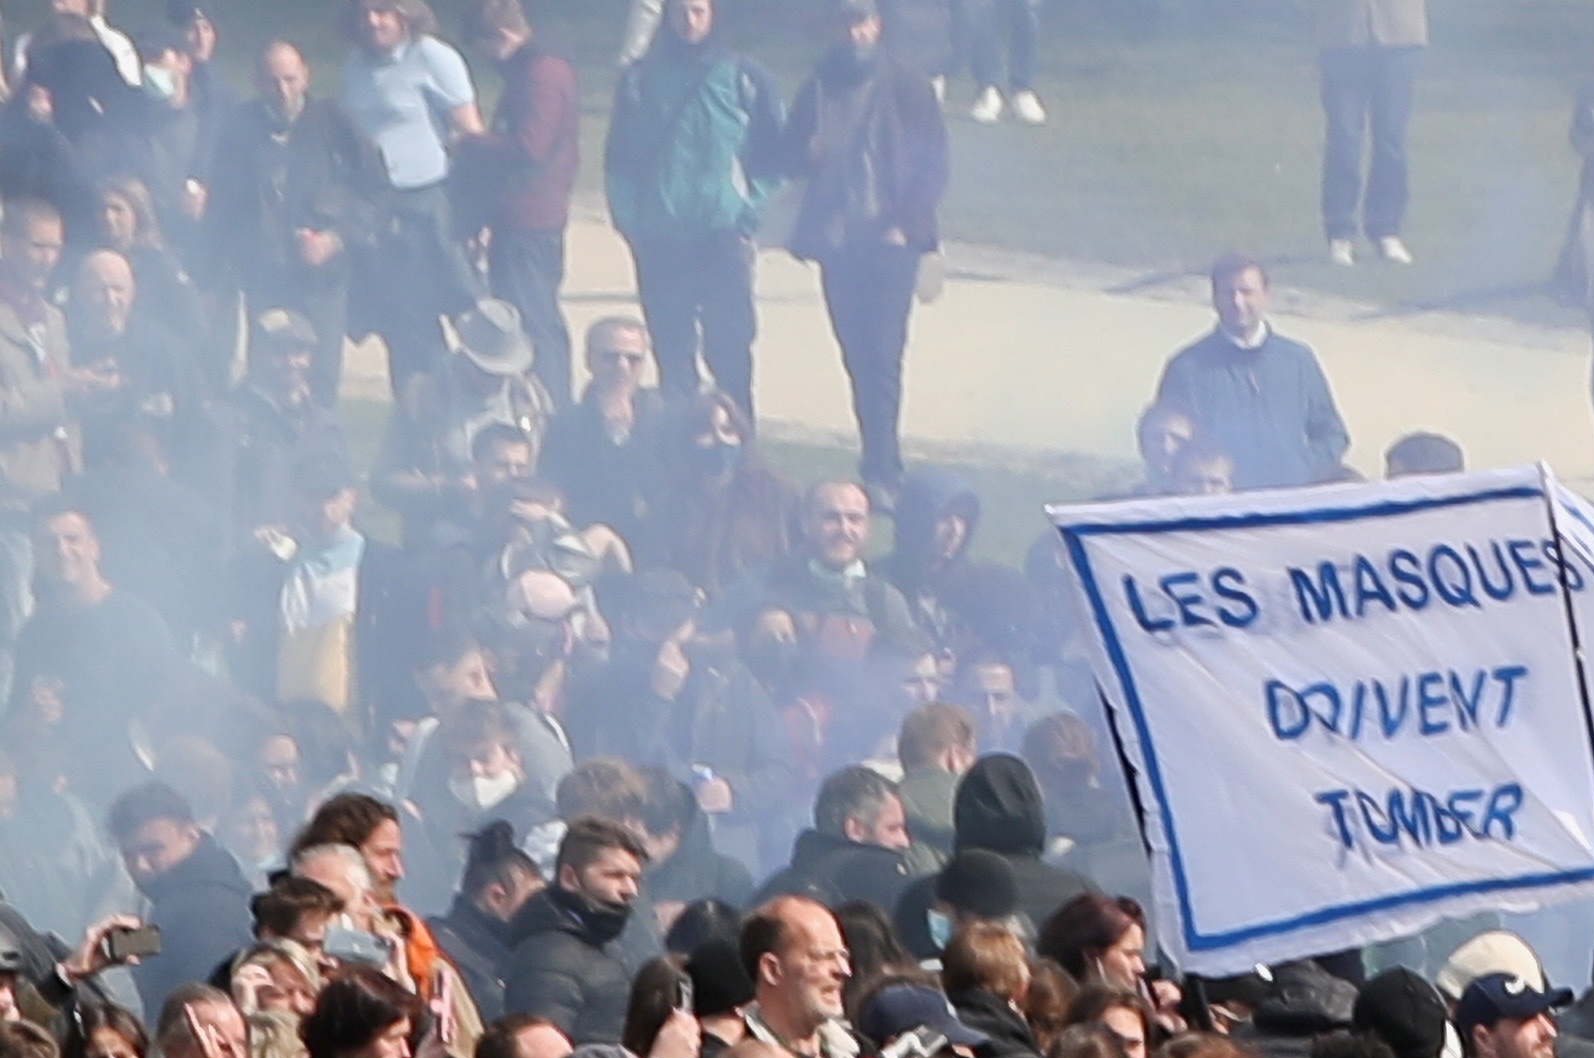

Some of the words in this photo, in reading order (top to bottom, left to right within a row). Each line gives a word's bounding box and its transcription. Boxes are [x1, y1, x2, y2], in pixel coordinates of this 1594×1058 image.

[1122, 567, 1258, 633] LES
[1288, 538, 1584, 623] MASQUES
[1264, 666, 1528, 740] DOIVENT
[1315, 784, 1523, 849] TOMBER
